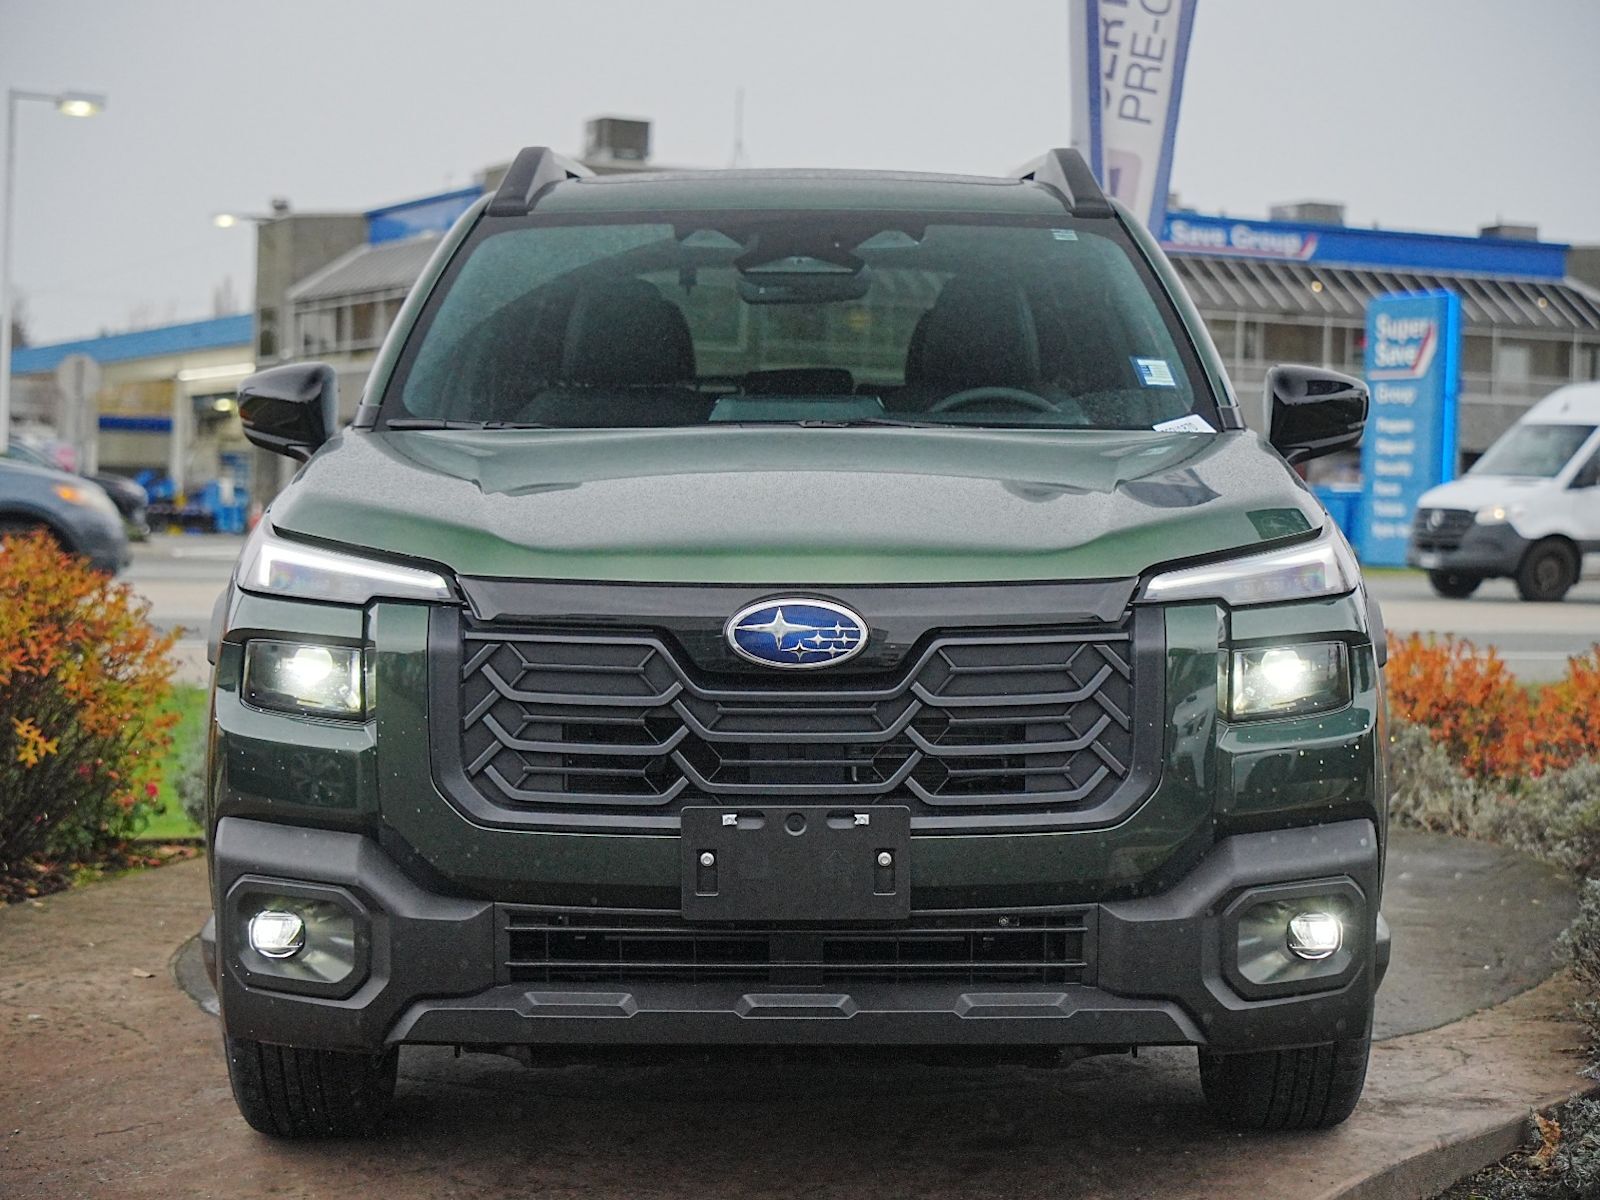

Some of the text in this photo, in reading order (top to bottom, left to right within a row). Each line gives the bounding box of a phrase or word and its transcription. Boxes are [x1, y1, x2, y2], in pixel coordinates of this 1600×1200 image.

[1231, 224, 1302, 256] Group
[1376, 314, 1428, 343] Super
[1375, 341, 1417, 367] Save
